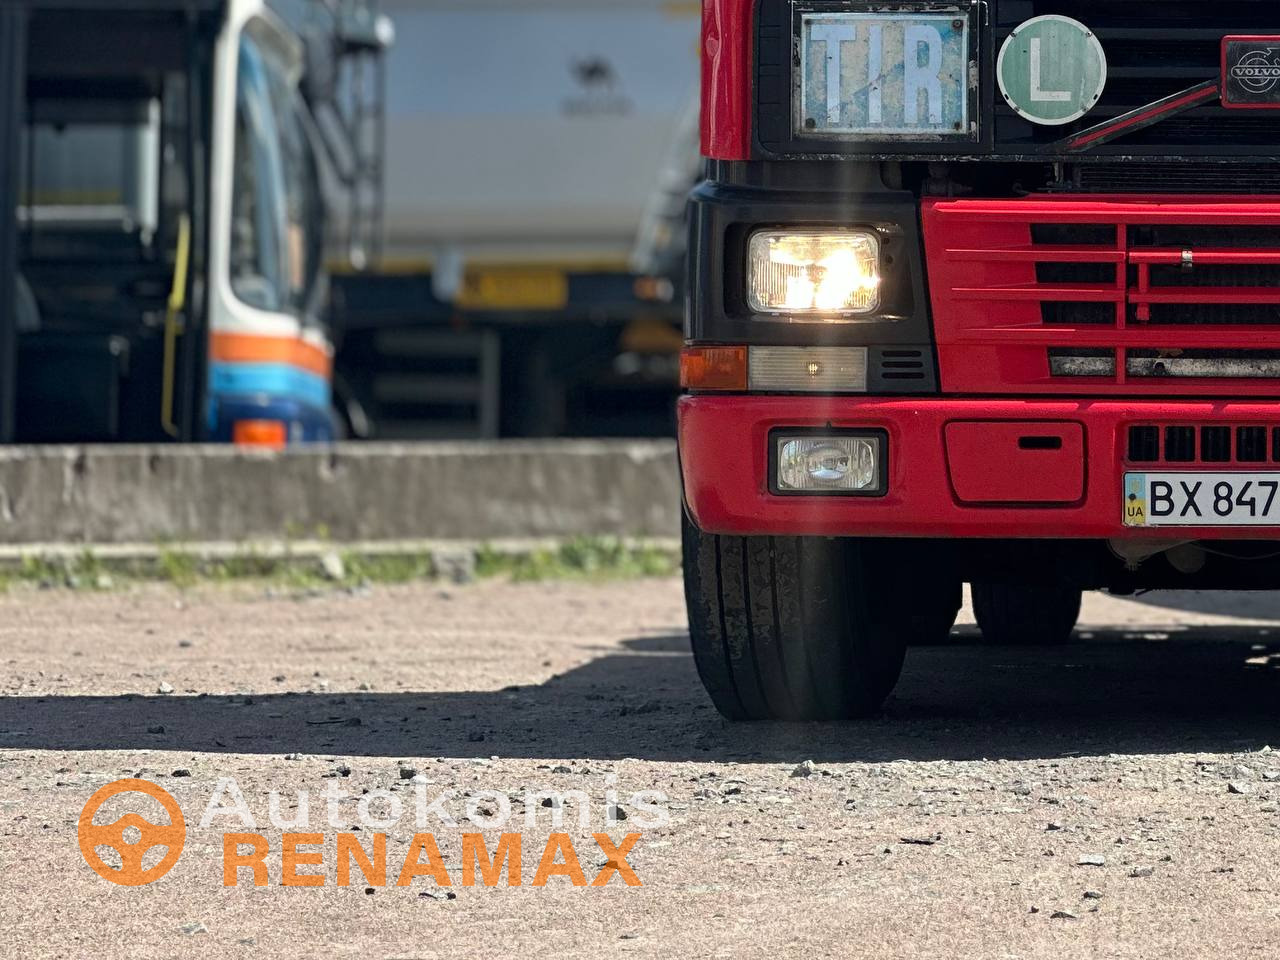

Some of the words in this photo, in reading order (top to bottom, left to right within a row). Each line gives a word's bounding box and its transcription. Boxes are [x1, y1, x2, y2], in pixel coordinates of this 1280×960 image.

[810, 23, 943, 125] TIR
[1030, 37, 1072, 102] L
[1234, 67, 1280, 76] VOLVO
[1127, 506, 1144, 517] UA
[1150, 480, 1203, 517] BX
